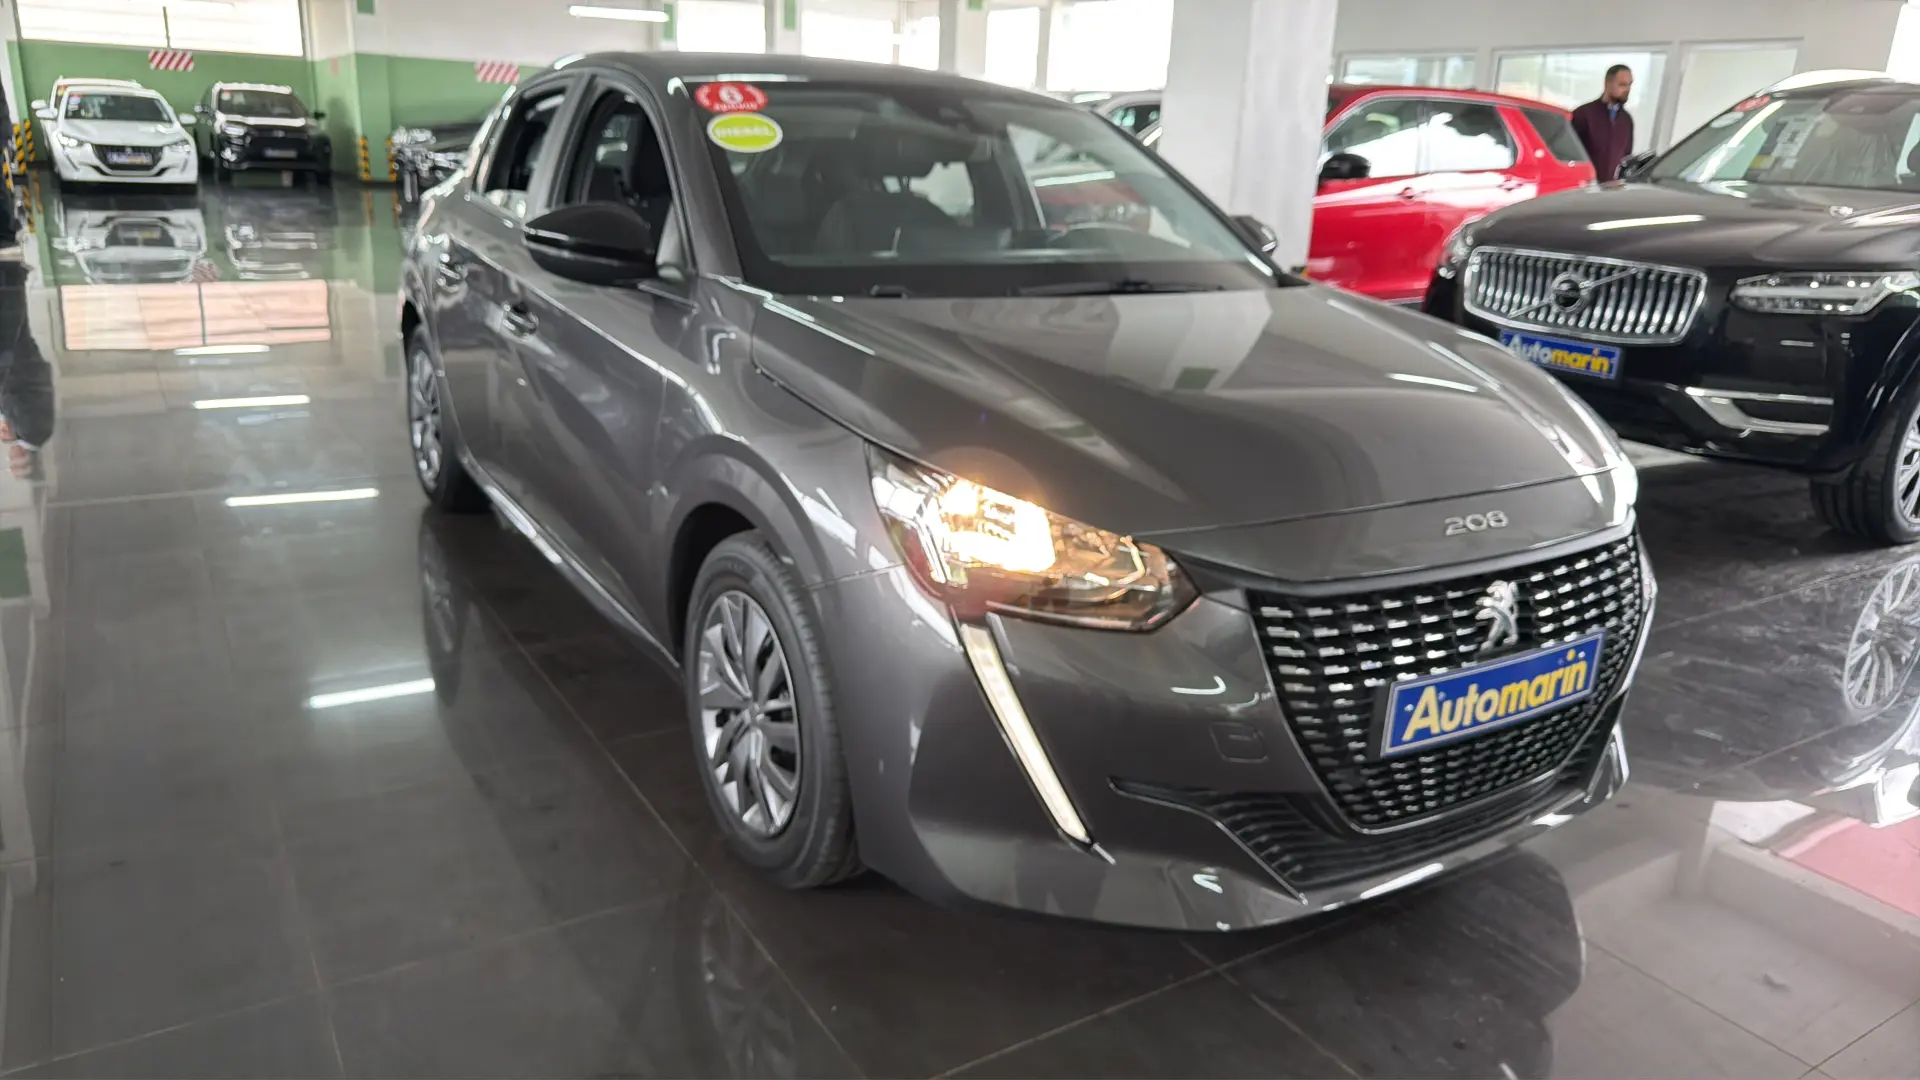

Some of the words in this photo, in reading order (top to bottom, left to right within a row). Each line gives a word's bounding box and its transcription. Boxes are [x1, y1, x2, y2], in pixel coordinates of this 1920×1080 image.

[1508, 333, 1610, 374] Automarin
[1444, 510, 1508, 536] 208
[1401, 648, 1588, 742] Automarin
